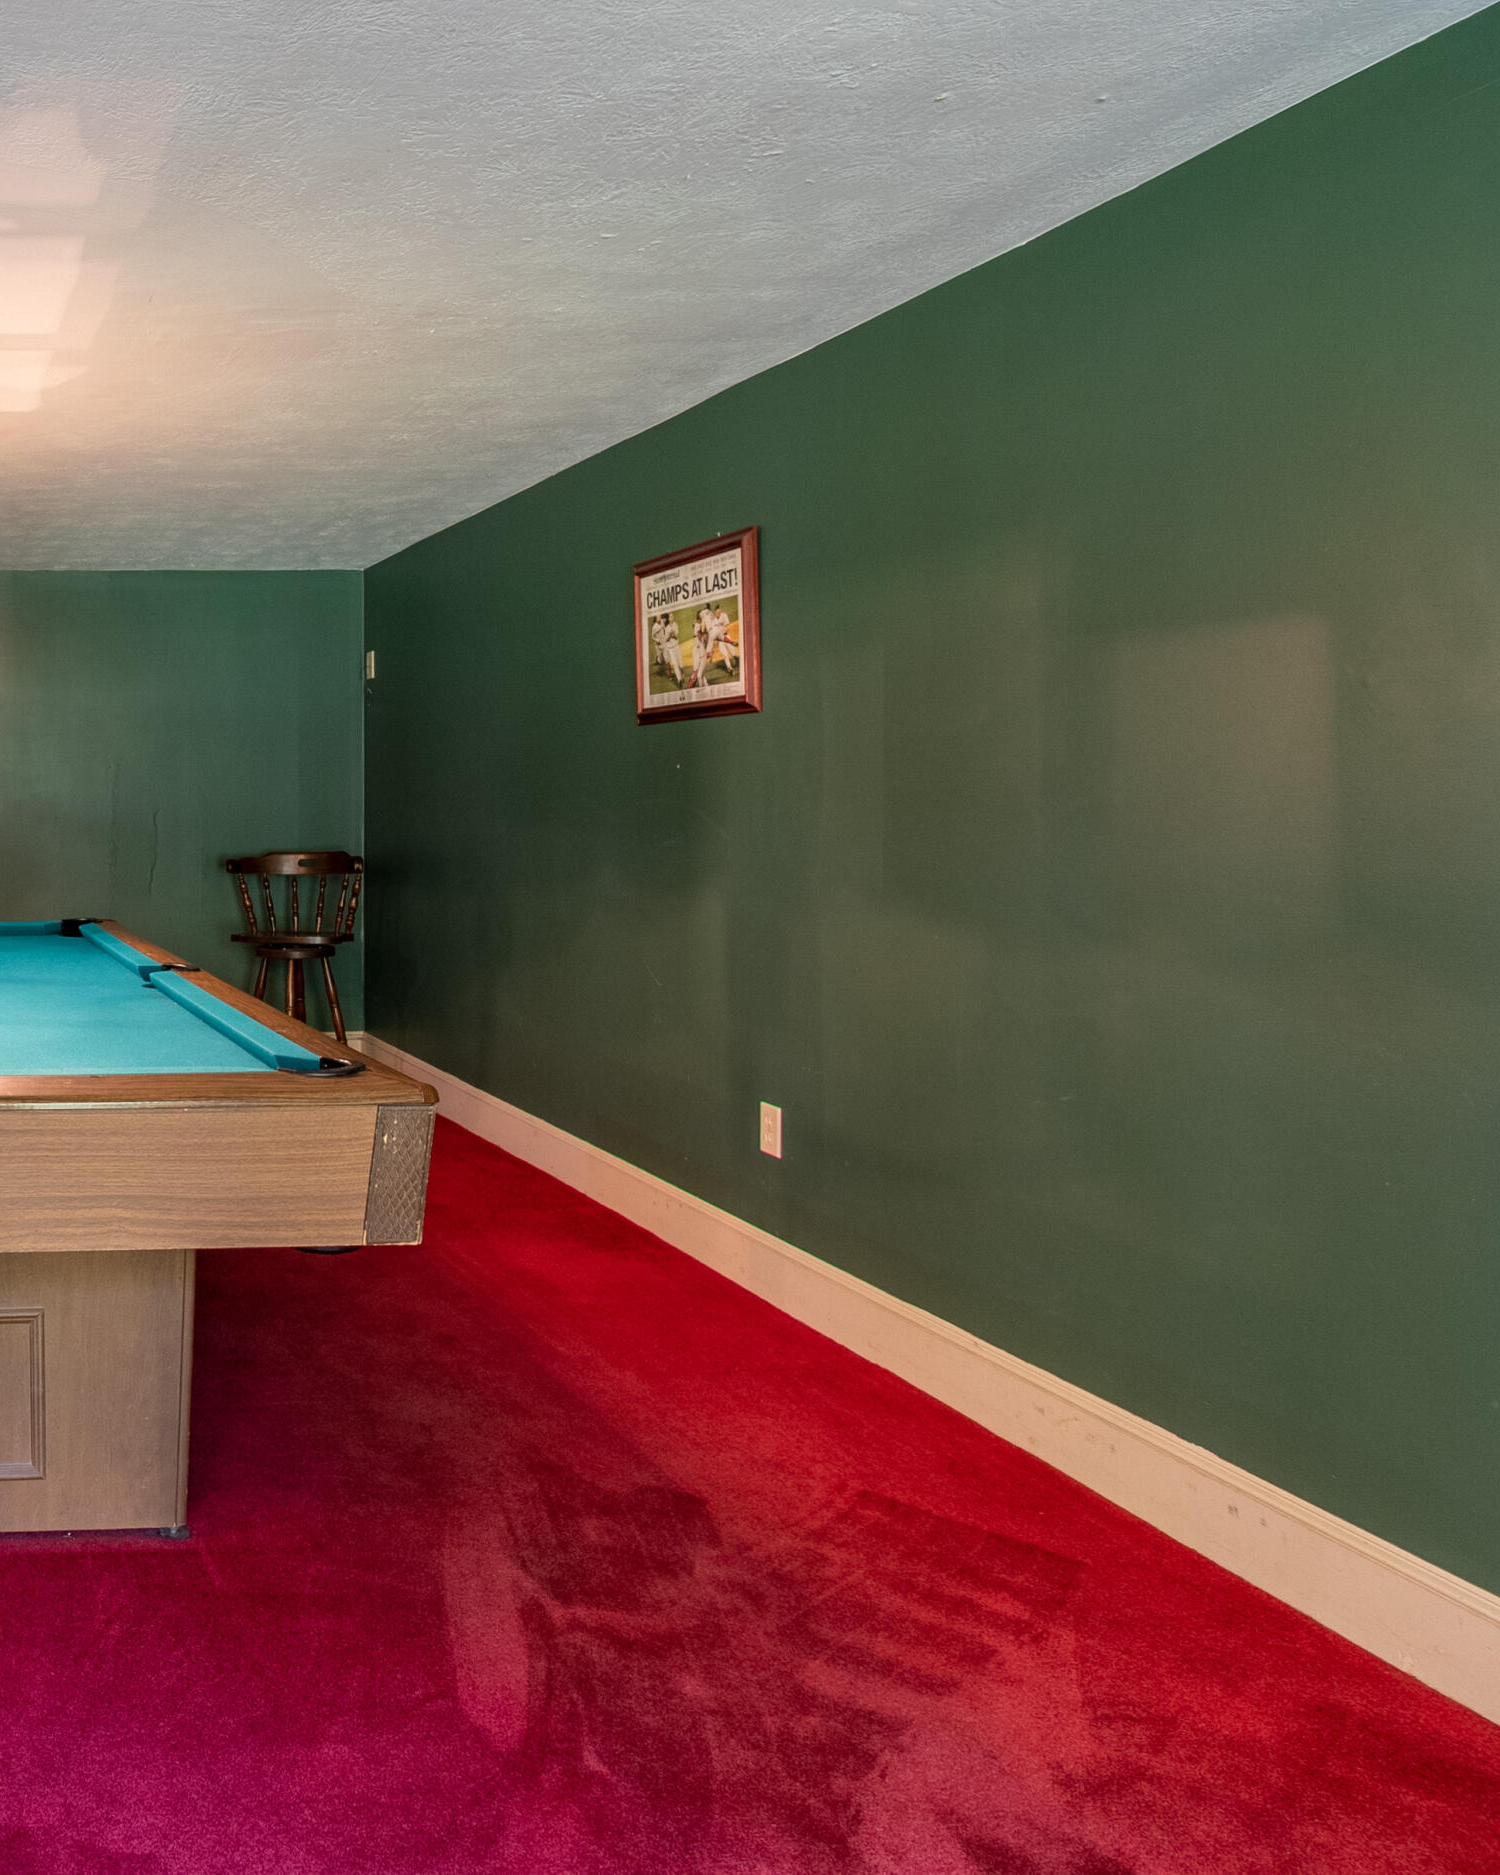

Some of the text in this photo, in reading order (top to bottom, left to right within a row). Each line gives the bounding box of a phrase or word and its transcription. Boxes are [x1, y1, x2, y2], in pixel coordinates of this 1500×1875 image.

[646, 582, 689, 609] CHAMPS
[691, 577, 703, 598] AT
[705, 568, 738, 593] LAST!
